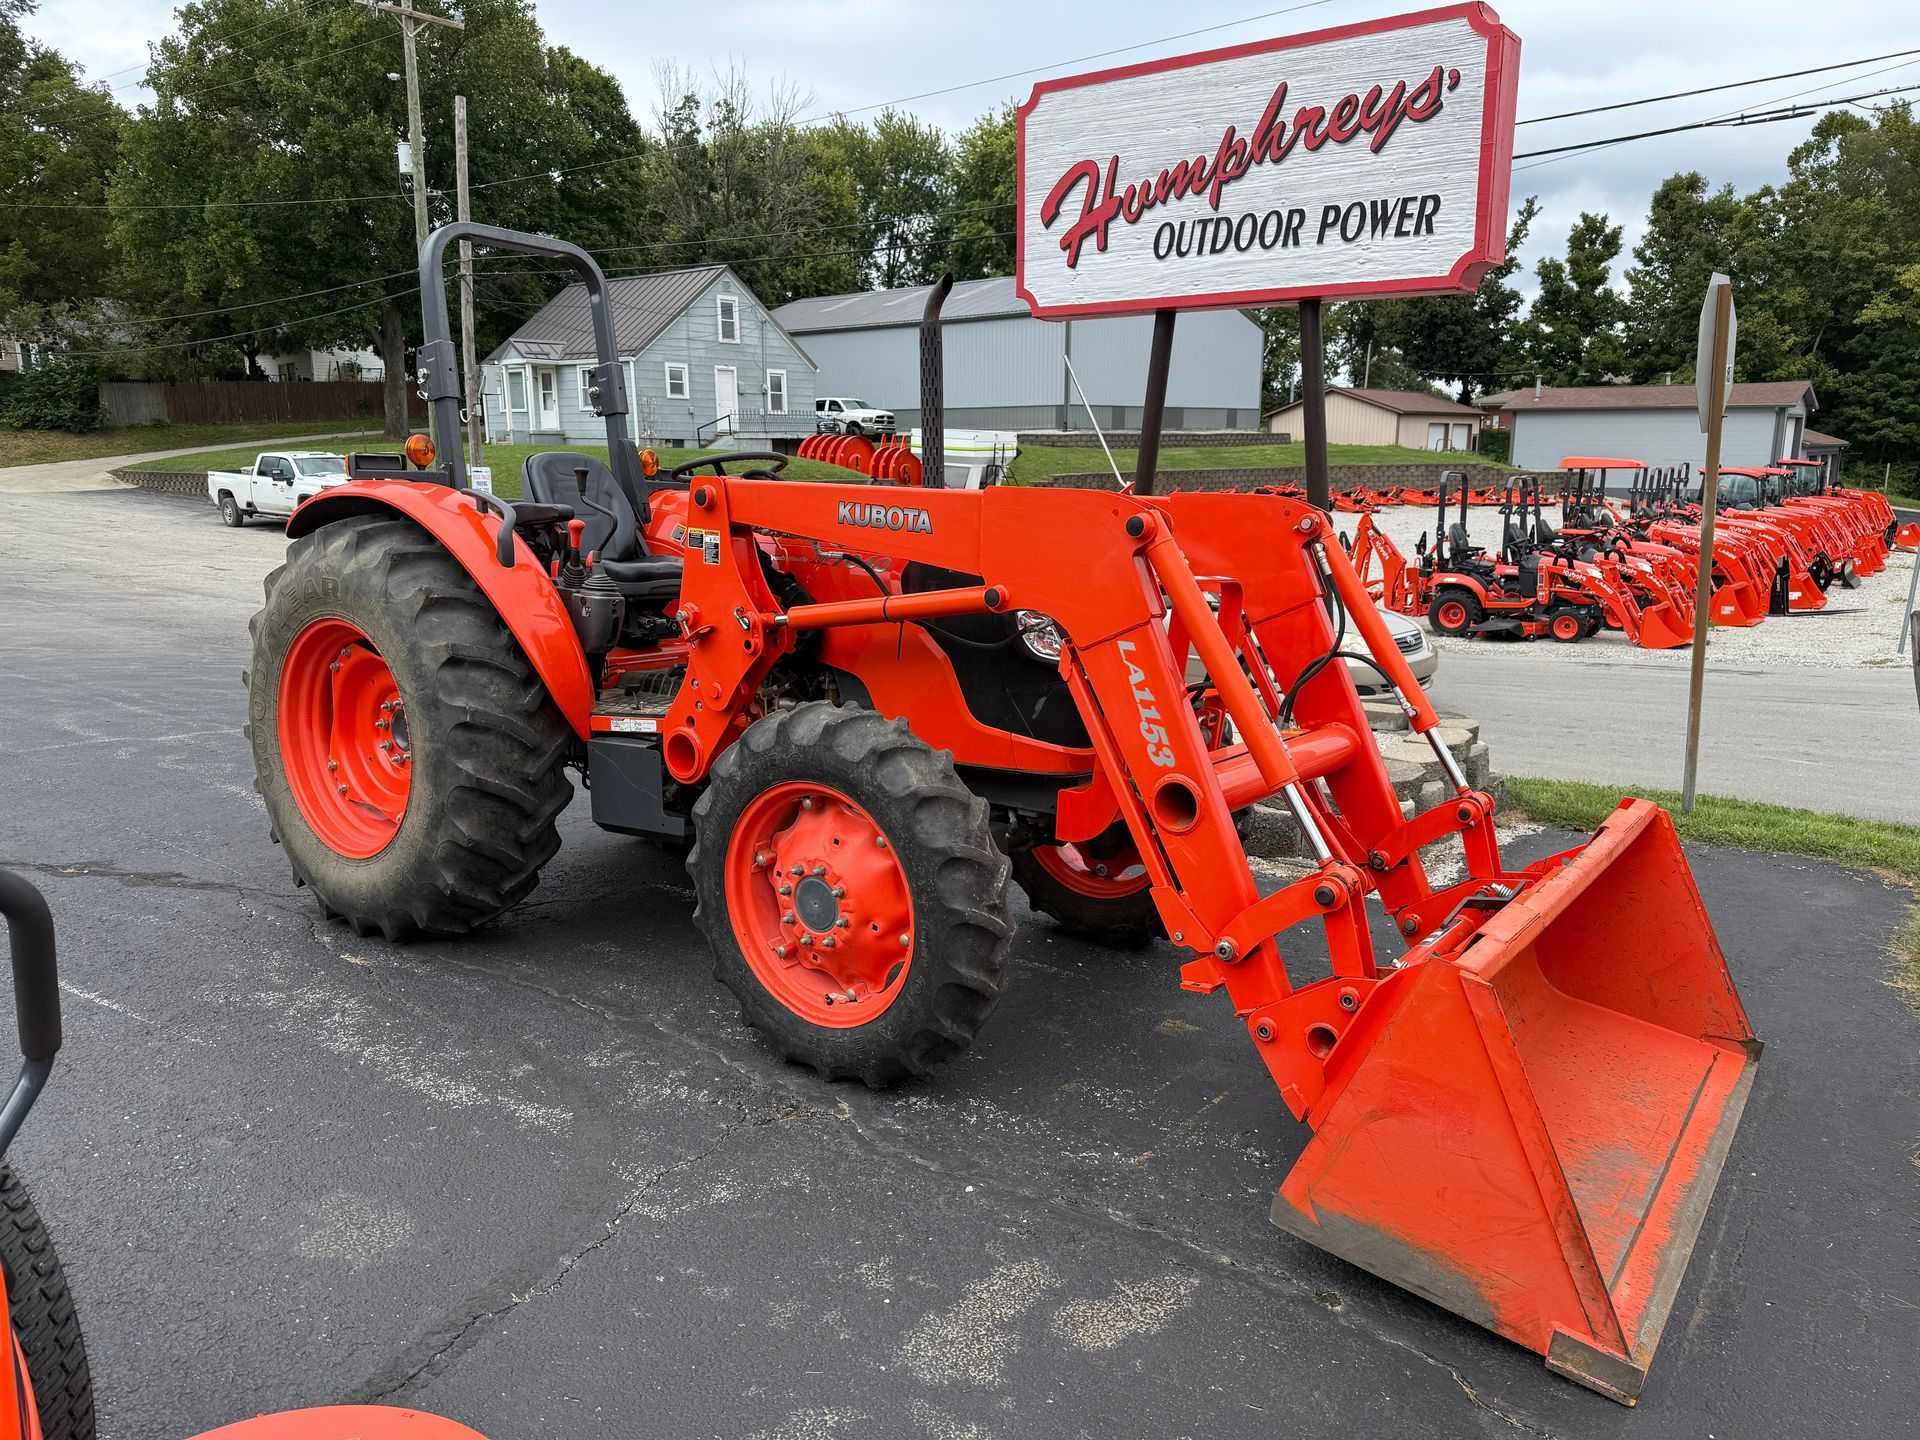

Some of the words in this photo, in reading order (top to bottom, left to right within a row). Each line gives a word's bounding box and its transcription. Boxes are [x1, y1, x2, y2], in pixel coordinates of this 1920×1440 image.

[1040, 65, 1461, 268] Humphreys'
[1153, 208, 1305, 260] OUTDOOR
[1317, 194, 1441, 245] POWER
[838, 500, 933, 534] KUBOTA
[1729, 525, 1752, 535] Kubota
[1682, 536, 1701, 547] Kubo
[1646, 552, 1667, 562] Kubota
[1563, 569, 1587, 582] Kubota
[1616, 563, 1637, 575] Kubota
[1117, 640, 1176, 768] LA1153
